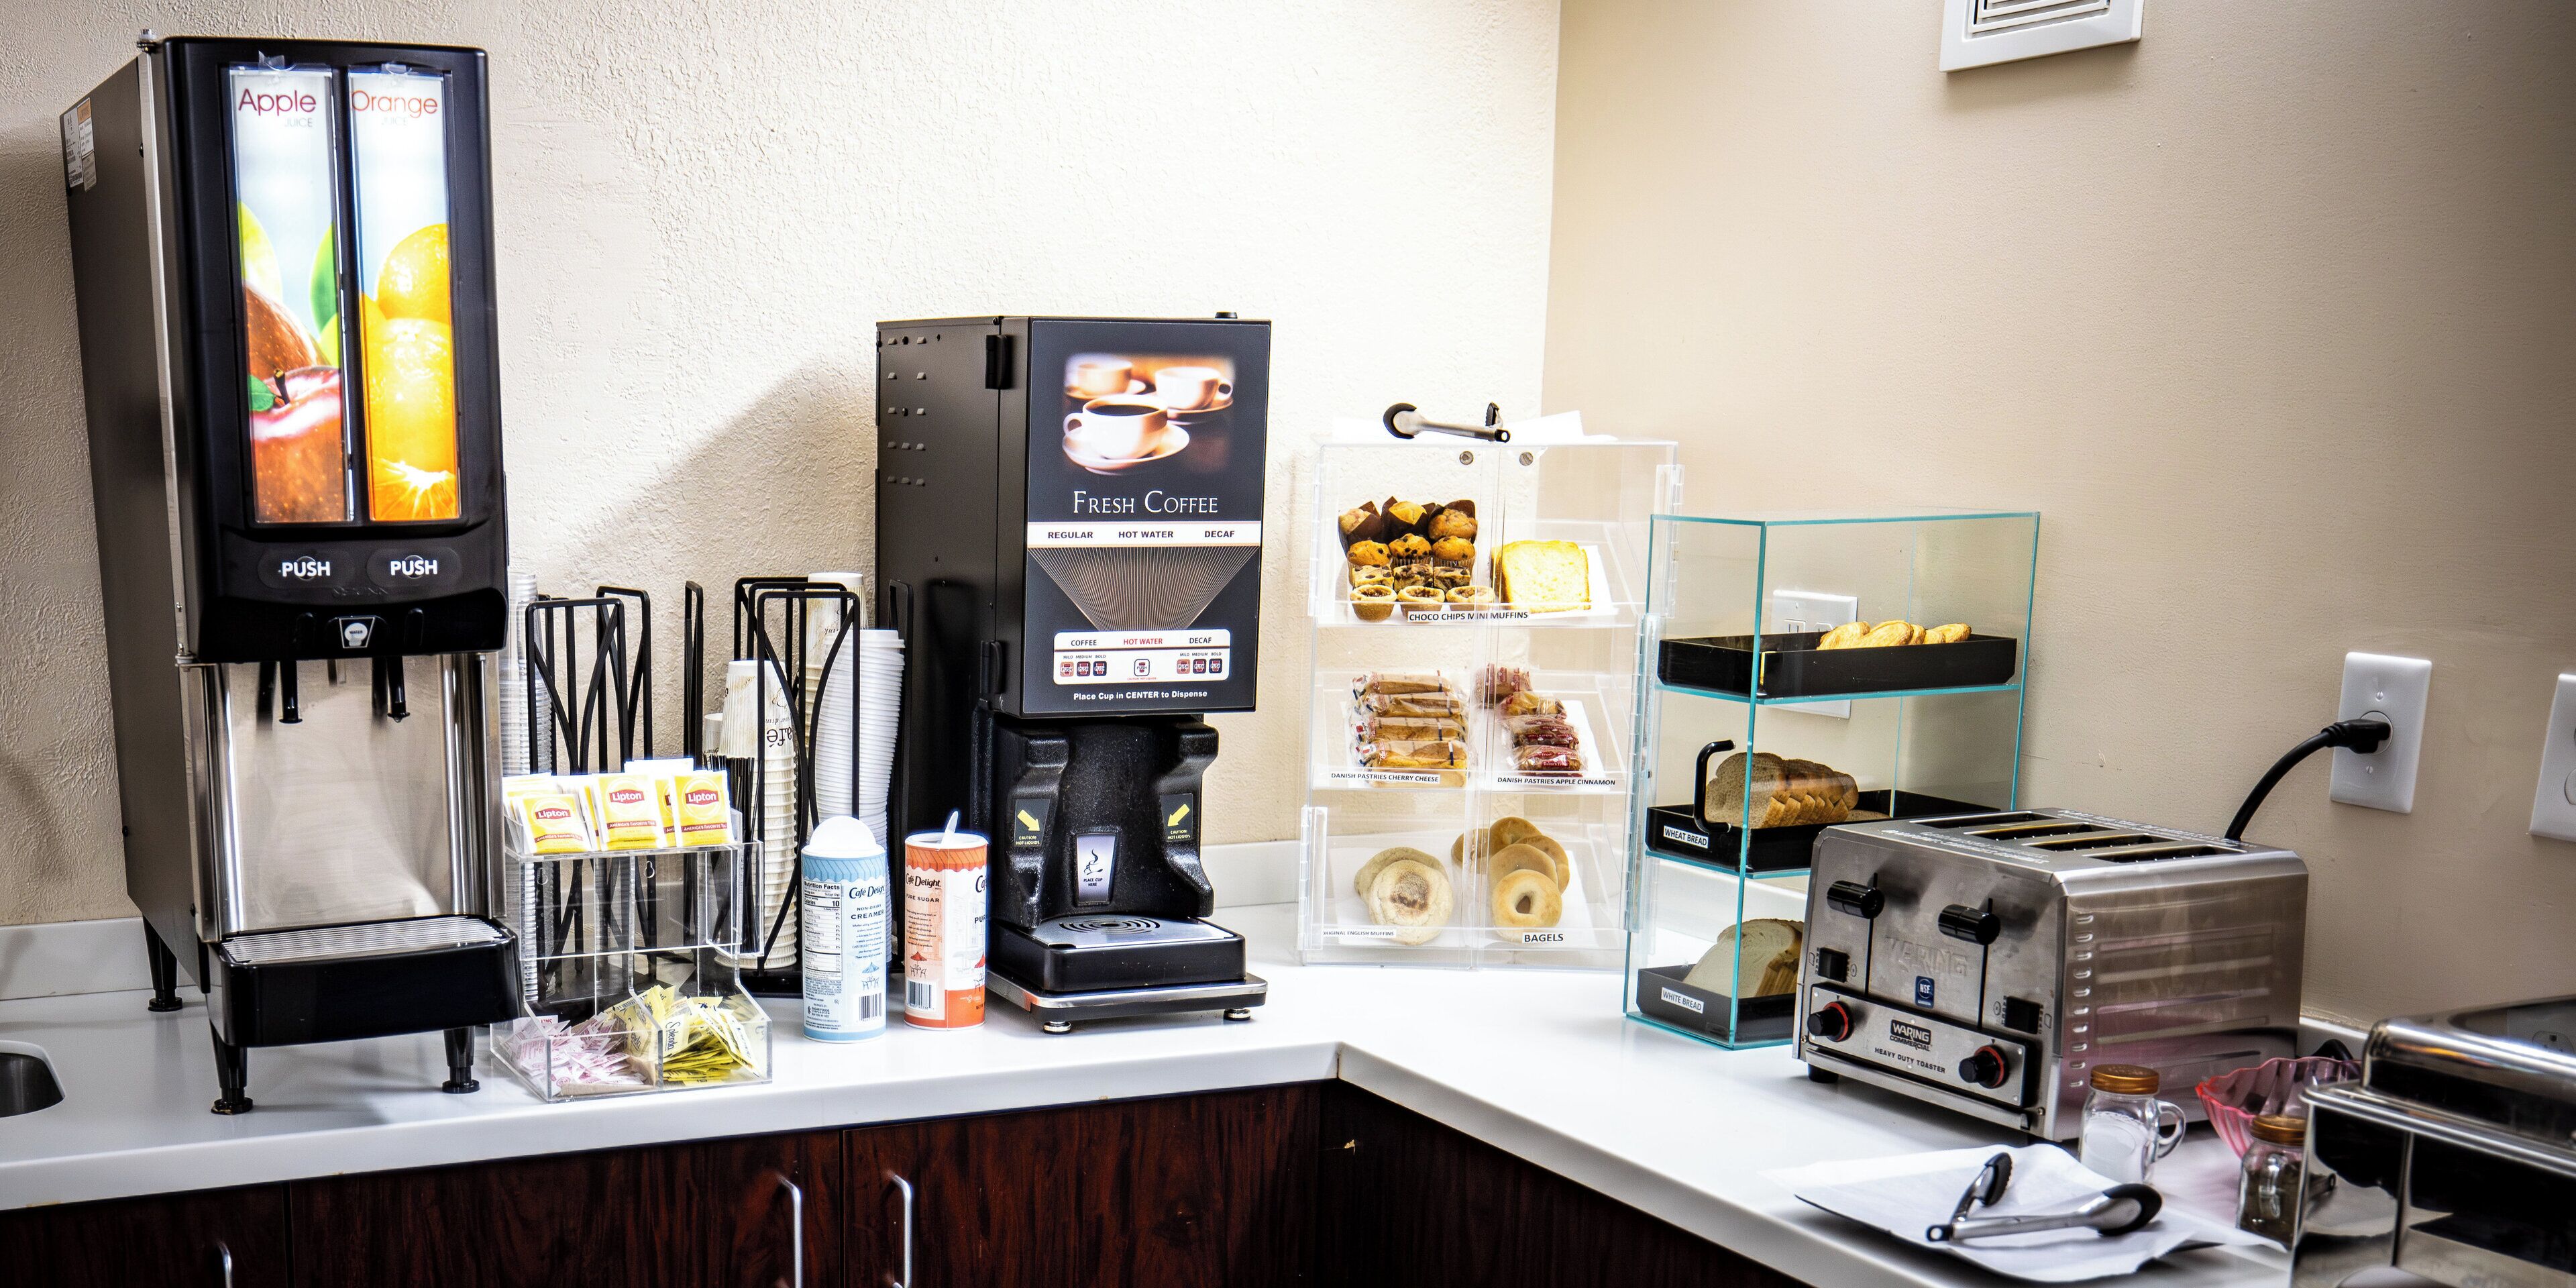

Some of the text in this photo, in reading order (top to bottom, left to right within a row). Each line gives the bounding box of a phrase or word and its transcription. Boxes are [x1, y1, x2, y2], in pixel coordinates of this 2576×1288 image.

[238, 89, 316, 116] Apple
[351, 90, 437, 118] Orange
[284, 118, 313, 127] JUICE
[382, 117, 407, 126] JUICE
[1073, 490, 1218, 513] FRESH COFFEE
[282, 561, 331, 577] PUSH
[390, 559, 438, 576] PUSH
[1409, 611, 1528, 621] CHOCO CHIPS MINI MUFFINS
[1073, 692, 1096, 700] Place
[1098, 692, 1114, 700] Cup
[1126, 691, 1159, 699] CENTER
[1171, 690, 1208, 699] Dispense
[766, 727, 792, 748] afé
[612, 792, 642, 802] Lipton
[688, 792, 717, 803] Lipton
[538, 810, 569, 818] Lipton
[1664, 828, 1707, 846] WHEAT BREAD
[915, 875, 941, 888] Delight
[849, 887, 867, 899] Café
[851, 909, 884, 920] CREAMER
[1523, 932, 1564, 943] BAGELS
[1919, 983, 1931, 994] NSF
[1663, 989, 1702, 1011] WHITE BREAD
[665, 1020, 681, 1052] Splenda
[1892, 1022, 1929, 1042] WARING
[1889, 1035, 1931, 1052] COMMERCIAL
[1874, 1046, 1946, 1074] HEAVY DUTY TOASTER
